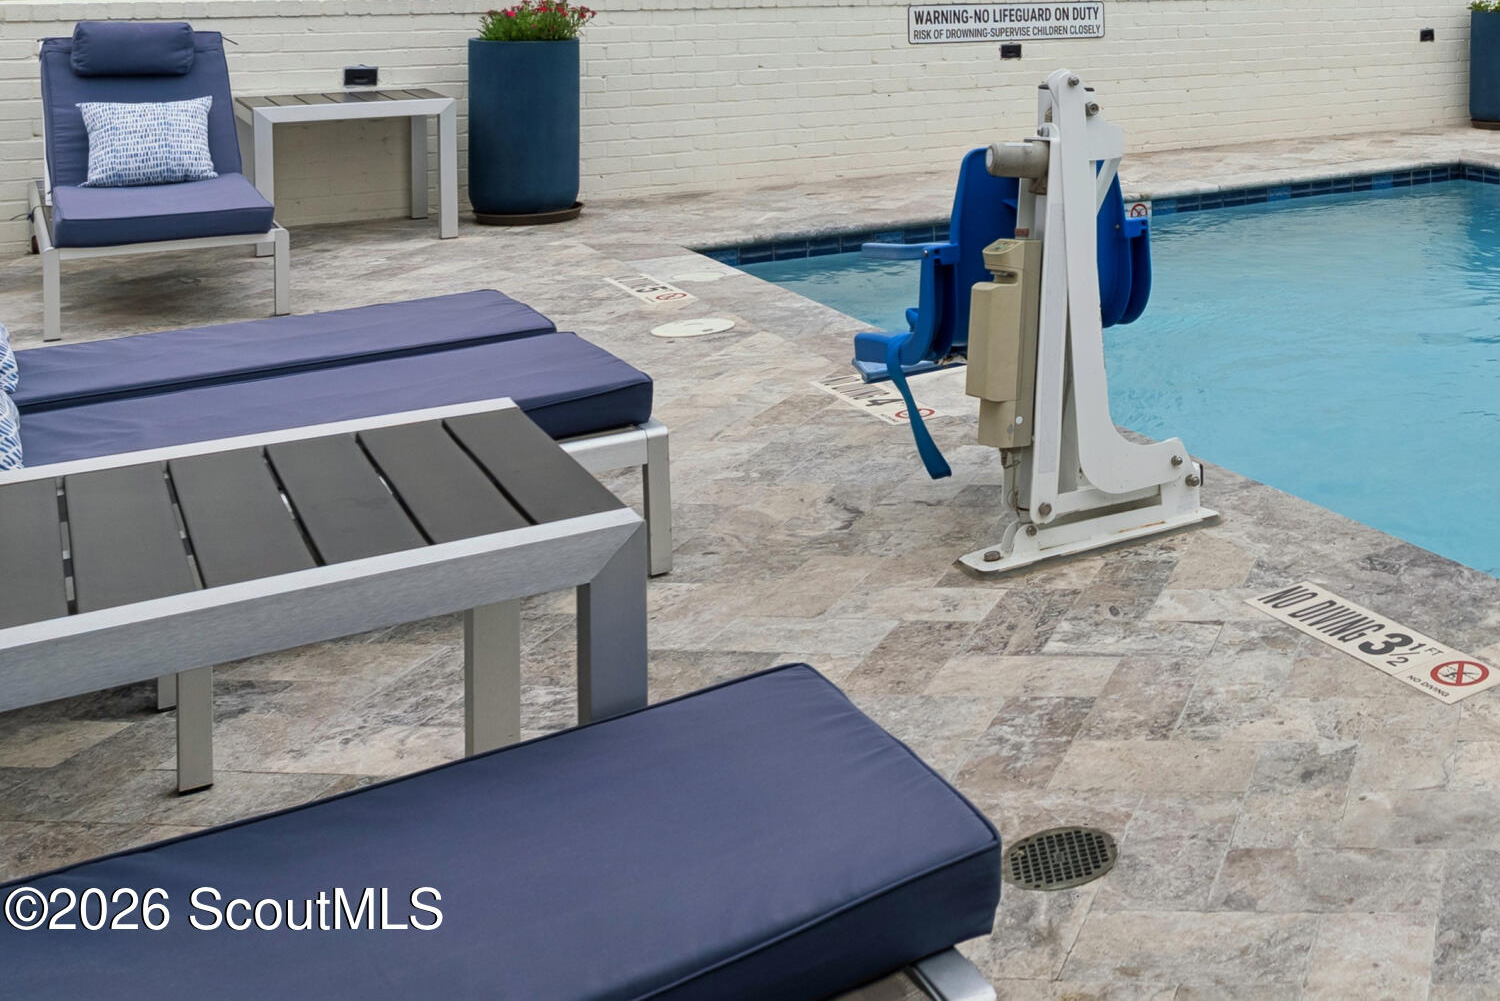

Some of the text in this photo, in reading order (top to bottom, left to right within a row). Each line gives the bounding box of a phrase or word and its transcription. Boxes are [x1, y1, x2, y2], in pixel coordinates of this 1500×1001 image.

[914, 6, 1100, 25] WARNING-NO LIFEGUARD ON DUTY
[913, 24, 1101, 41] RISK OF DROWNING-SUPERVISE CHILDREN CLOSELY
[1257, 585, 1318, 609] NO
[1287, 600, 1386, 643] DIVING
[1424, 646, 1444, 656] FT
[1407, 674, 1451, 698] NO DIVING
